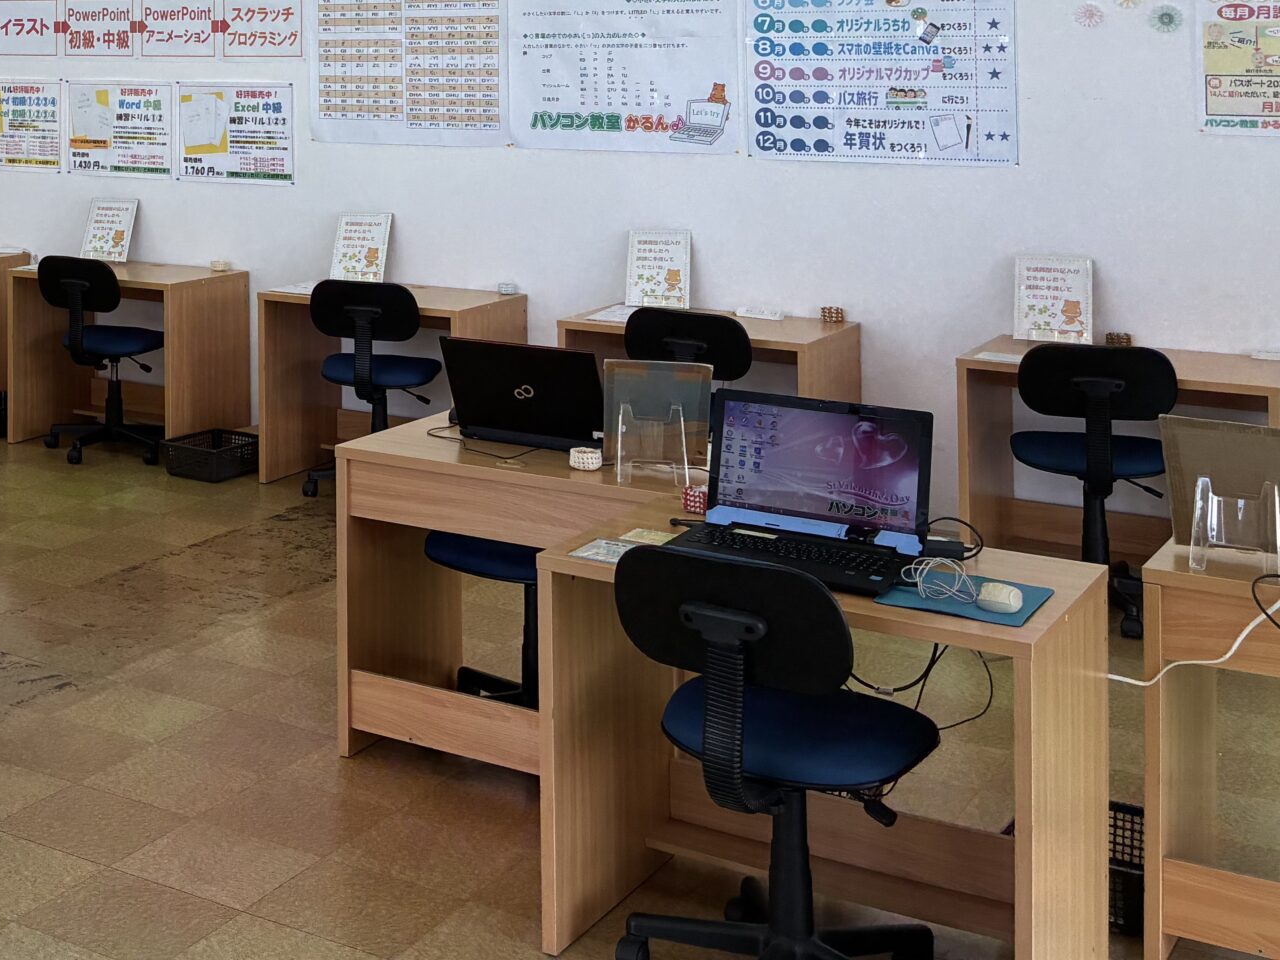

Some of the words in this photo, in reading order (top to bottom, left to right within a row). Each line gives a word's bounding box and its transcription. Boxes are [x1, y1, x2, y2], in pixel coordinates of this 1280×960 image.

[68, 8, 130, 22] PowerPoint
[144, 7, 211, 21] PowerPoint
[231, 7, 294, 22] スクラッチ
[0, 18, 50, 36] イラスト
[836, 18, 911, 33] オリジナルうちわ
[940, 22, 972, 31] をつくろう!
[69, 30, 130, 49] 初級・中級
[146, 30, 211, 44] アニメーション
[227, 30, 298, 46] プログラミング
[838, 42, 939, 56] スマホの壁紙をCanva
[941, 46, 972, 55] でつくろう!
[838, 66, 930, 81] オリジナルマグカップ
[942, 72, 973, 81] をつくろう!
[118, 99, 141, 109] Word
[143, 99, 161, 110] 中級
[838, 90, 878, 105] バス旅行
[942, 96, 969, 104] に行こう!
[234, 102, 259, 112] Excel
[262, 102, 282, 113] 中級
[692, 108, 709, 116] Let's
[710, 109, 720, 118] try
[530, 111, 622, 132] パソコン教室
[845, 118, 925, 129] 今年こそはオリジナルで!
[1204, 119, 1259, 129] パソコン教室
[843, 131, 886, 151] 年賀状
[889, 143, 928, 153] をつくろう!
